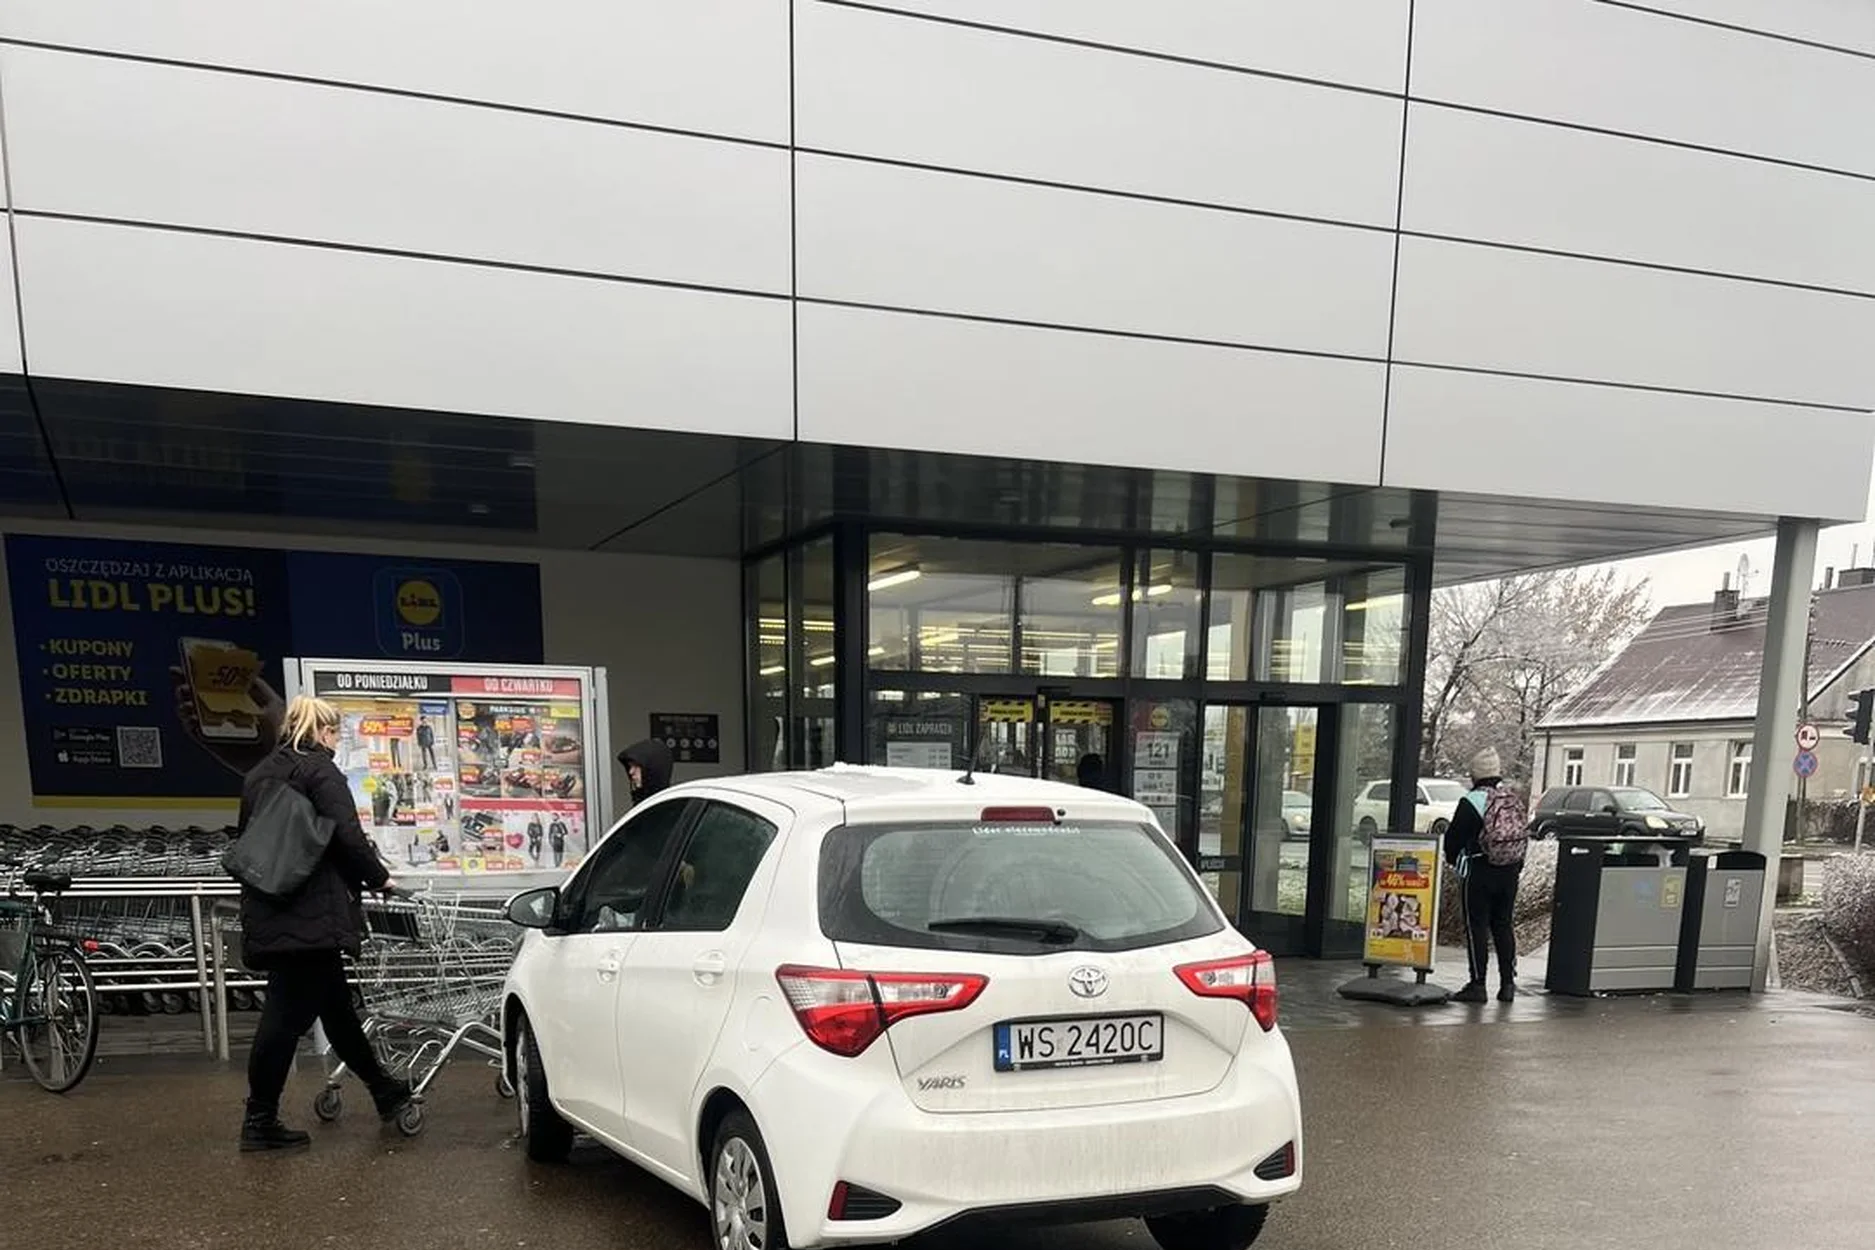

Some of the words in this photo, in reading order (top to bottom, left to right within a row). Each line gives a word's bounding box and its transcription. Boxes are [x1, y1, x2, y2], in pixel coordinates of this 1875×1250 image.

[45, 557, 150, 579] OSZCZĘDZAJ
[155, 563, 167, 578] Z
[167, 564, 254, 586] APLIKACJĄ
[48, 578, 140, 612] LIDL
[148, 583, 257, 617] PLUS!
[50, 639, 134, 658] KUPONY
[402, 632, 441, 652] Plus
[52, 663, 133, 682] OFERTY
[337, 674, 352, 688] OD
[355, 674, 428, 691] PONIEDZIAŁKU
[485, 678, 499, 692] OD
[502, 678, 554, 693] CZWARTKU
[55, 687, 149, 707] ZDRAPKI
[1018, 1026, 1055, 1059] WS
[1067, 1020, 1154, 1056] 2420C
[916, 1075, 967, 1092] YARIS
